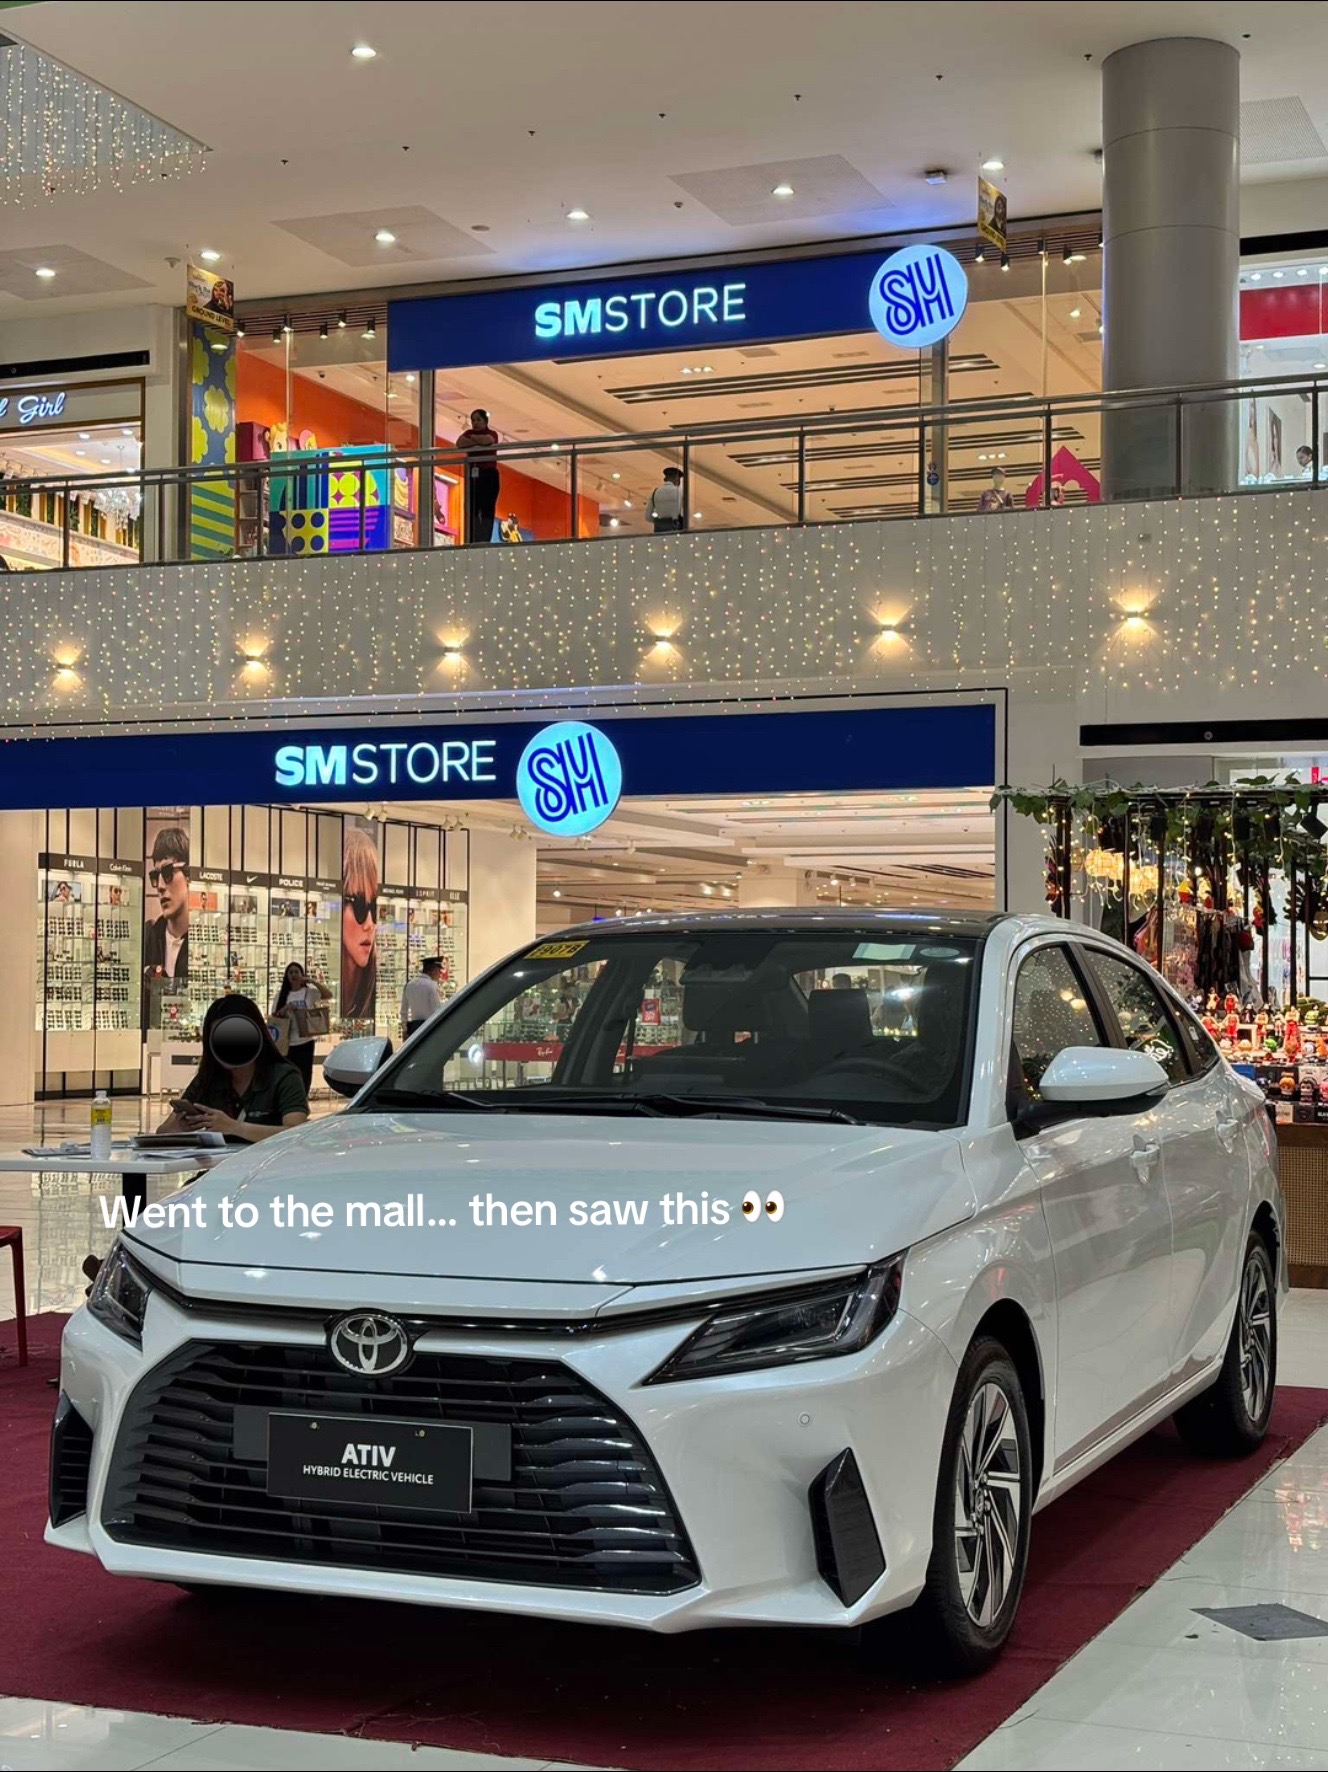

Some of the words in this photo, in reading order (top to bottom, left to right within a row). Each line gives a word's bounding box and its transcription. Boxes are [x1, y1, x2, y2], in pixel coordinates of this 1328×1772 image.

[17, 392, 65, 424] Girl
[63, 858, 85, 869] FURLA
[199, 872, 223, 881] LACOSTE
[279, 878, 303, 888] POLICE
[415, 890, 435, 898] ESPRIT
[341, 1443, 396, 1467] ATIV
[303, 1464, 341, 1477] HYBRID
[343, 1467, 389, 1481] ELECTRIC
[391, 1471, 434, 1485] VEHICLE
